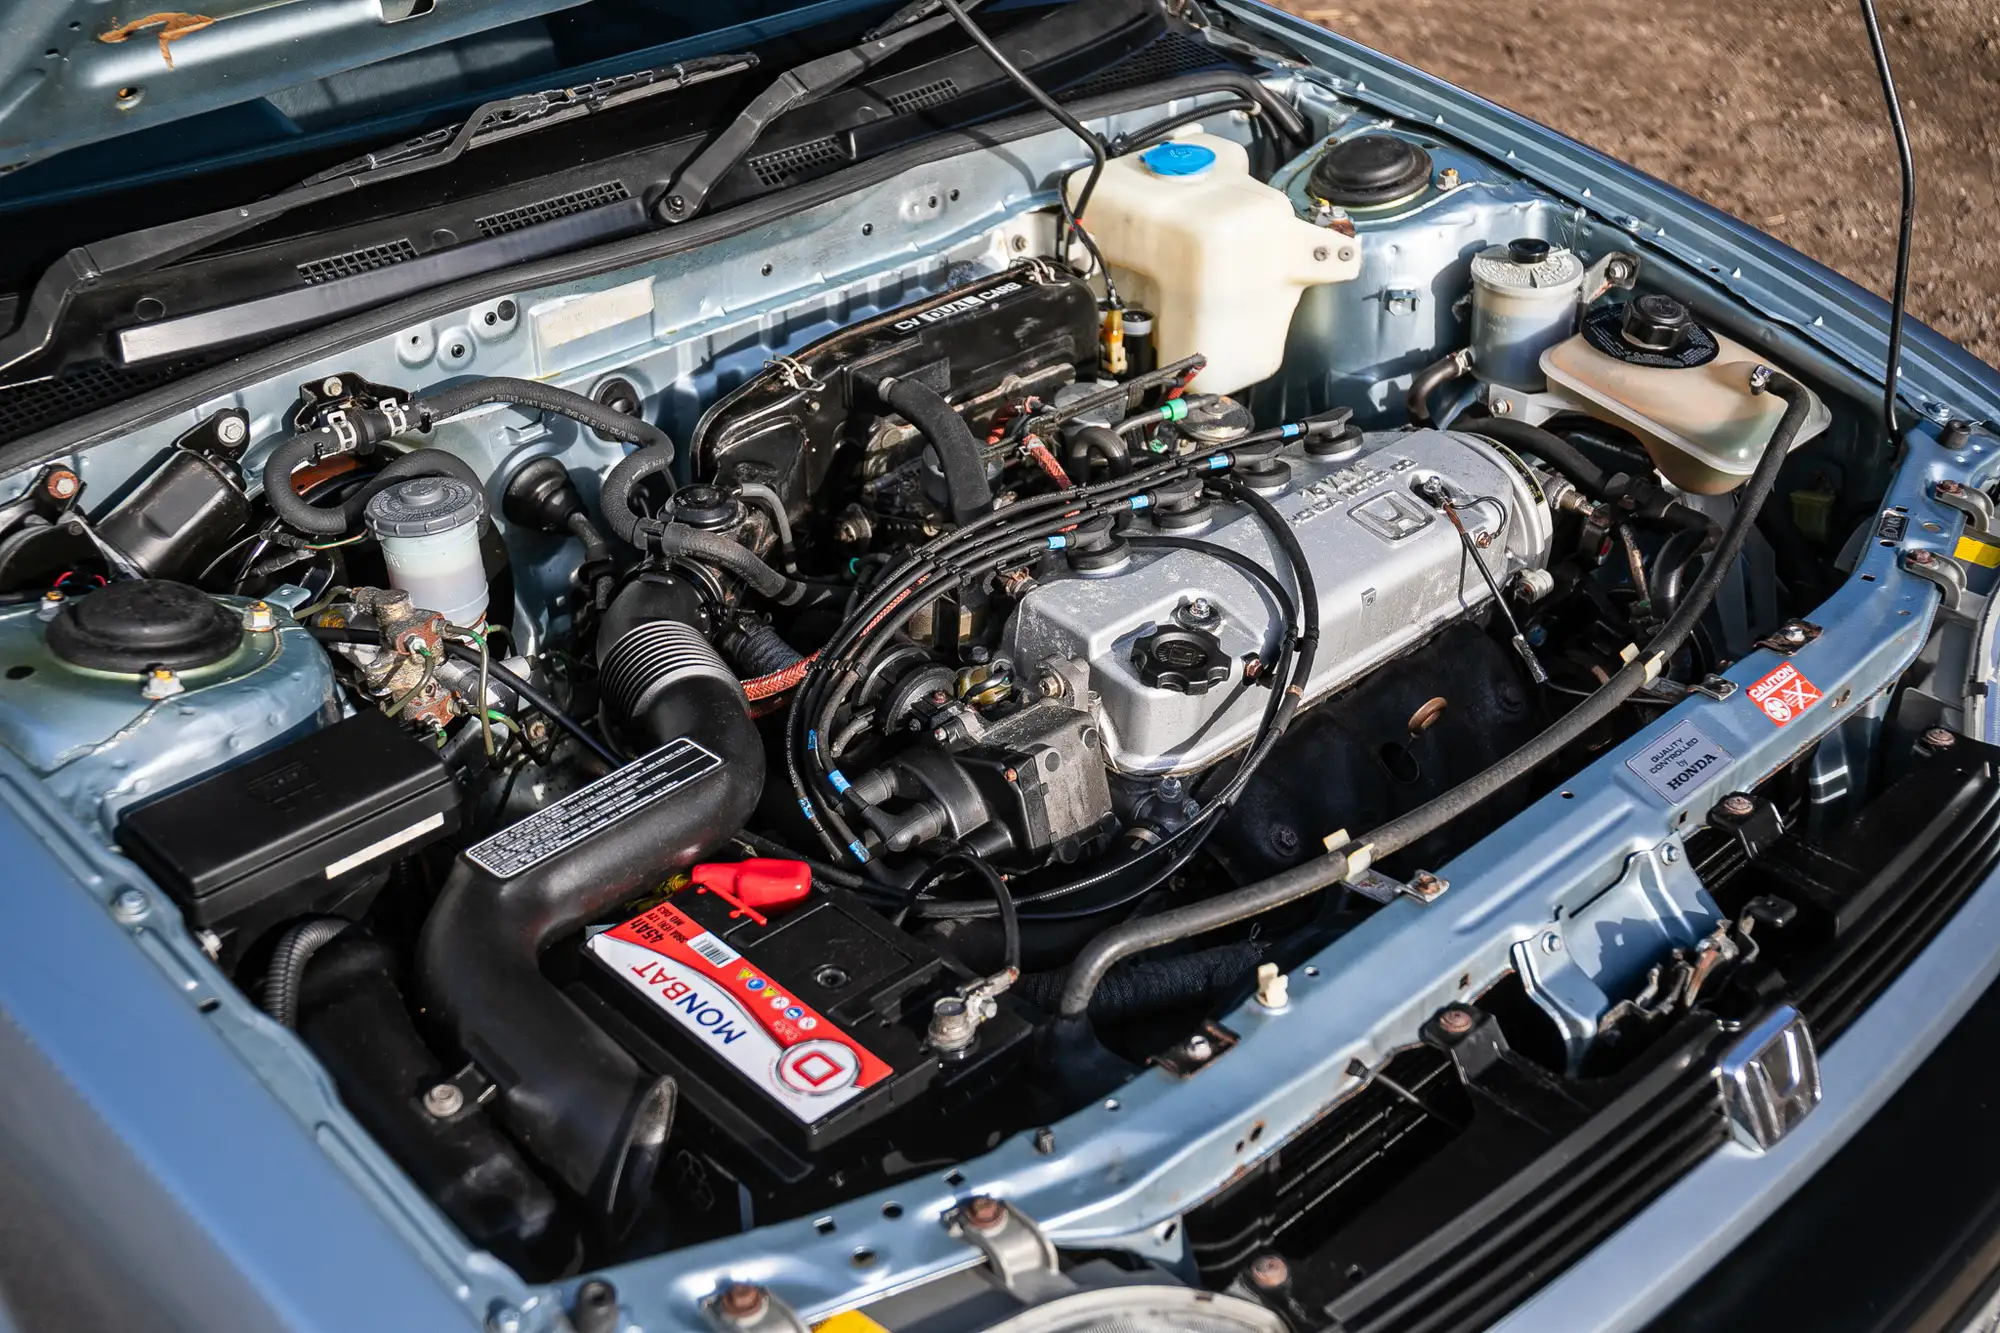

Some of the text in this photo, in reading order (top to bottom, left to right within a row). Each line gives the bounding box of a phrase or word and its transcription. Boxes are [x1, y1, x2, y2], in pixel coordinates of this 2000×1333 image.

[894, 281, 1022, 331] CV DUAL CARB
[1749, 664, 1796, 699] CAUTION
[1649, 737, 1699, 774] CONTROLLED
[1650, 738, 1685, 763] QUALITY
[1676, 759, 1689, 769] by
[1666, 753, 1718, 791] HONDA
[630, 917, 665, 944] 45Ah
[631, 961, 748, 1045] MONBAT
